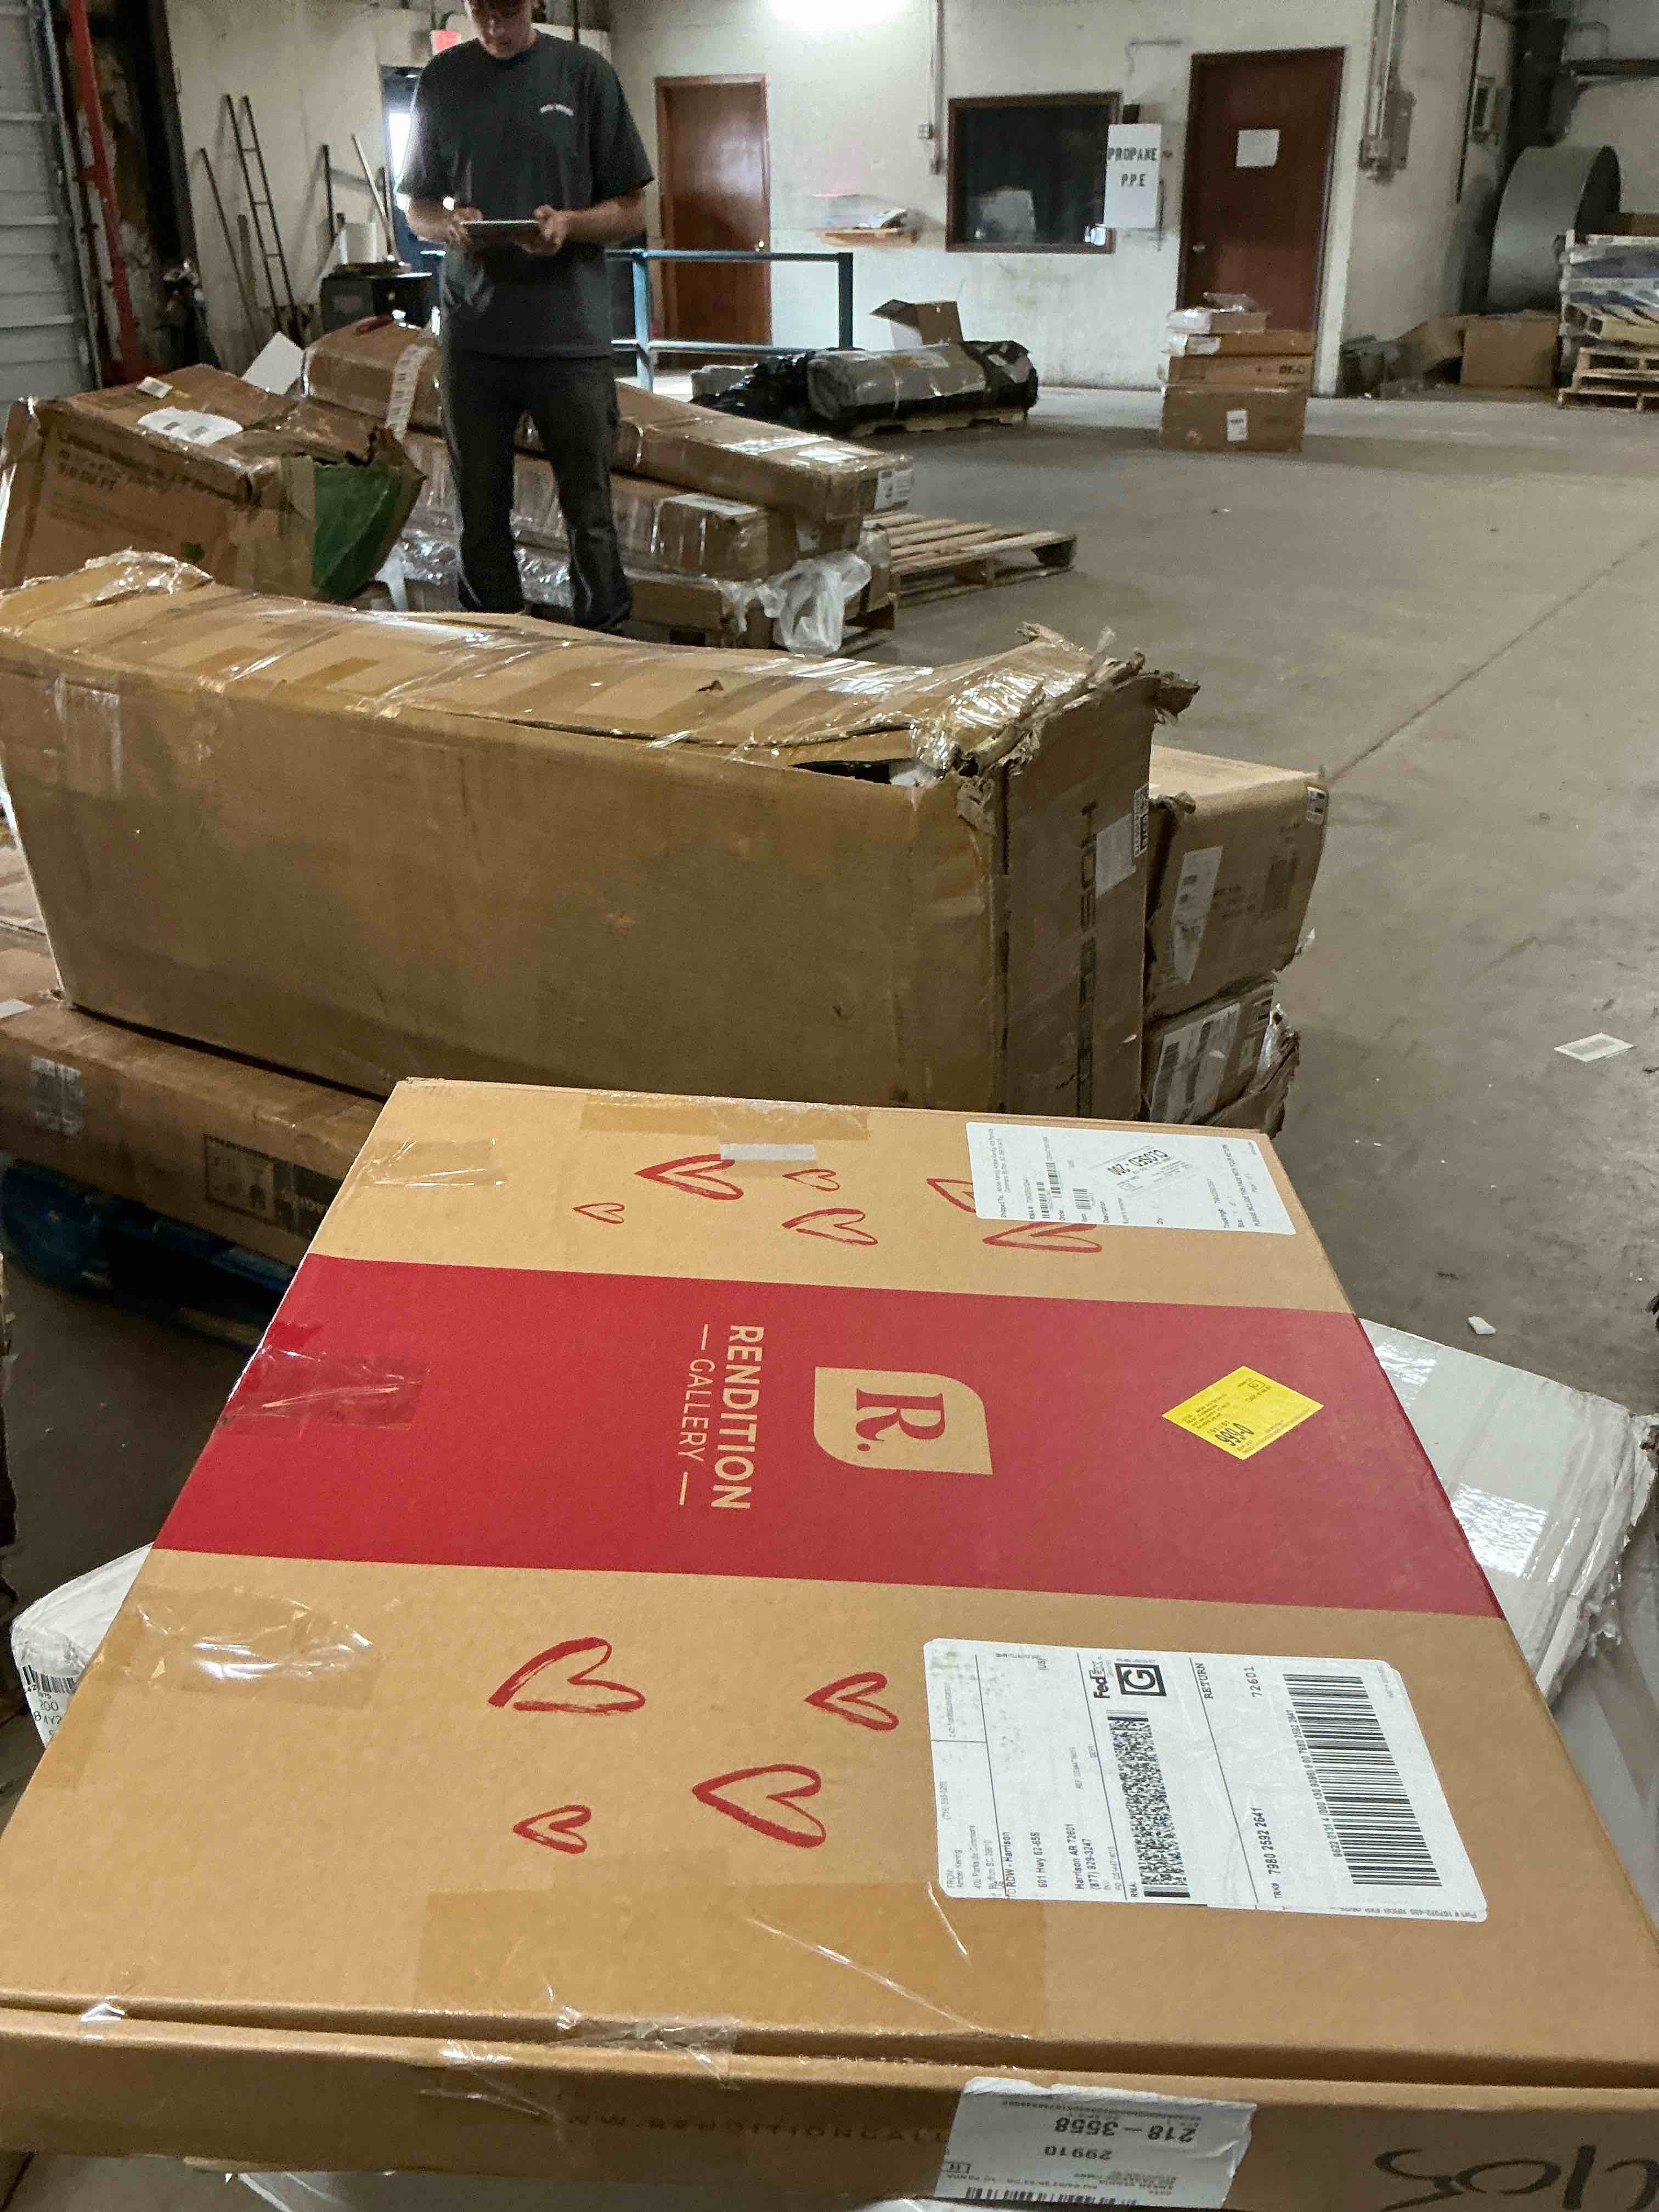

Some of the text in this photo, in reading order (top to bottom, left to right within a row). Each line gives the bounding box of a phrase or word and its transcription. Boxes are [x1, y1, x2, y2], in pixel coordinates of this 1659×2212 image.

[1107, 147, 1158, 161] PROPANE
[1121, 173, 1146, 187] PPE
[678, 1358, 715, 1462] GALLERY
[710, 1324, 765, 1509] RENDITION
[1088, 1661, 1111, 1699] FedEx
[1123, 1669, 1156, 1690] G
[1195, 1663, 1214, 1699] RETURN
[1244, 1667, 1262, 1697] 72601
[1249, 1807, 1267, 1827] 2641
[1002, 1832, 1013, 1862] Harrison
[1257, 1830, 1274, 1850] 2592
[1035, 1857, 1047, 1873] Hwy
[1064, 1824, 1085, 1889] Harrison AR 72601
[1263, 1854, 1281, 1875] 7980
[1005, 1869, 1017, 1888] RDW
[1087, 1872, 1102, 1890] (877)
[1054, 2118, 1120, 2137] 3558
[1147, 2125, 1197, 2143] 218
[1044, 2145, 1113, 2161] 29910
